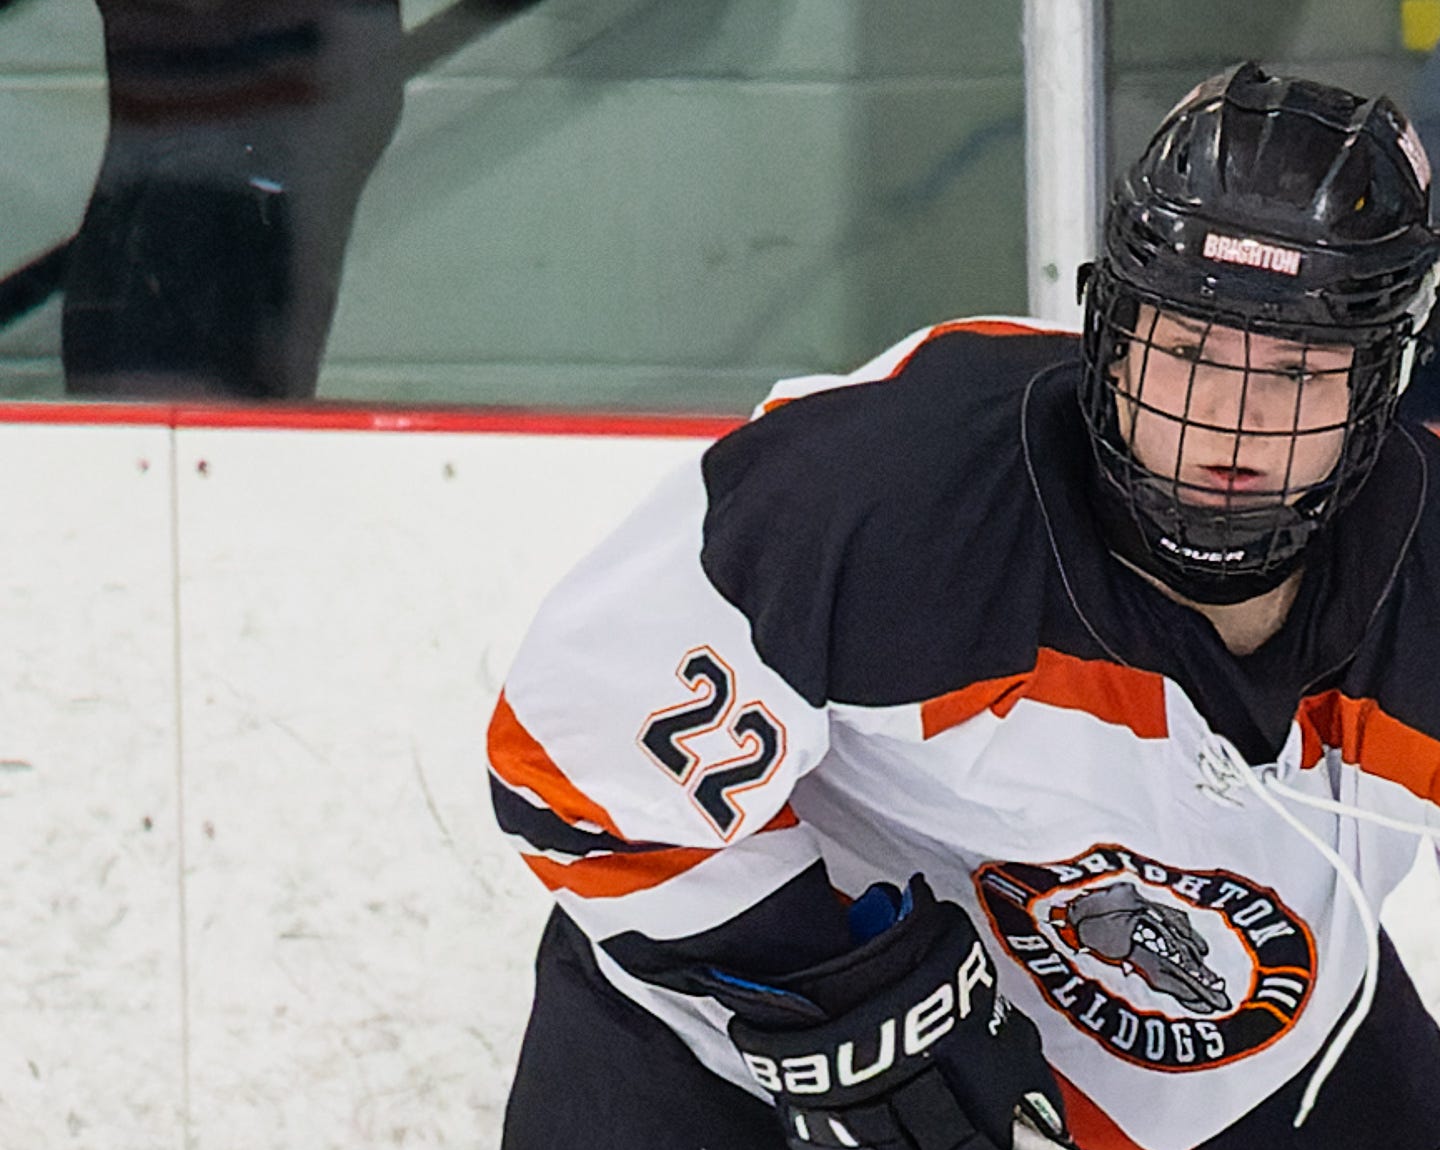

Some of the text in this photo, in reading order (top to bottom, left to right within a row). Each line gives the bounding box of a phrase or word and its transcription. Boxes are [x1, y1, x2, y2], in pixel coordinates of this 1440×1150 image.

[1203, 232, 1301, 277] BRIGHTON
[636, 645, 787, 843] 22
[1049, 850, 1297, 948] BRIGHTON
[743, 940, 994, 1095] BAUER
[1006, 933, 1225, 1064] BULLDOGS
